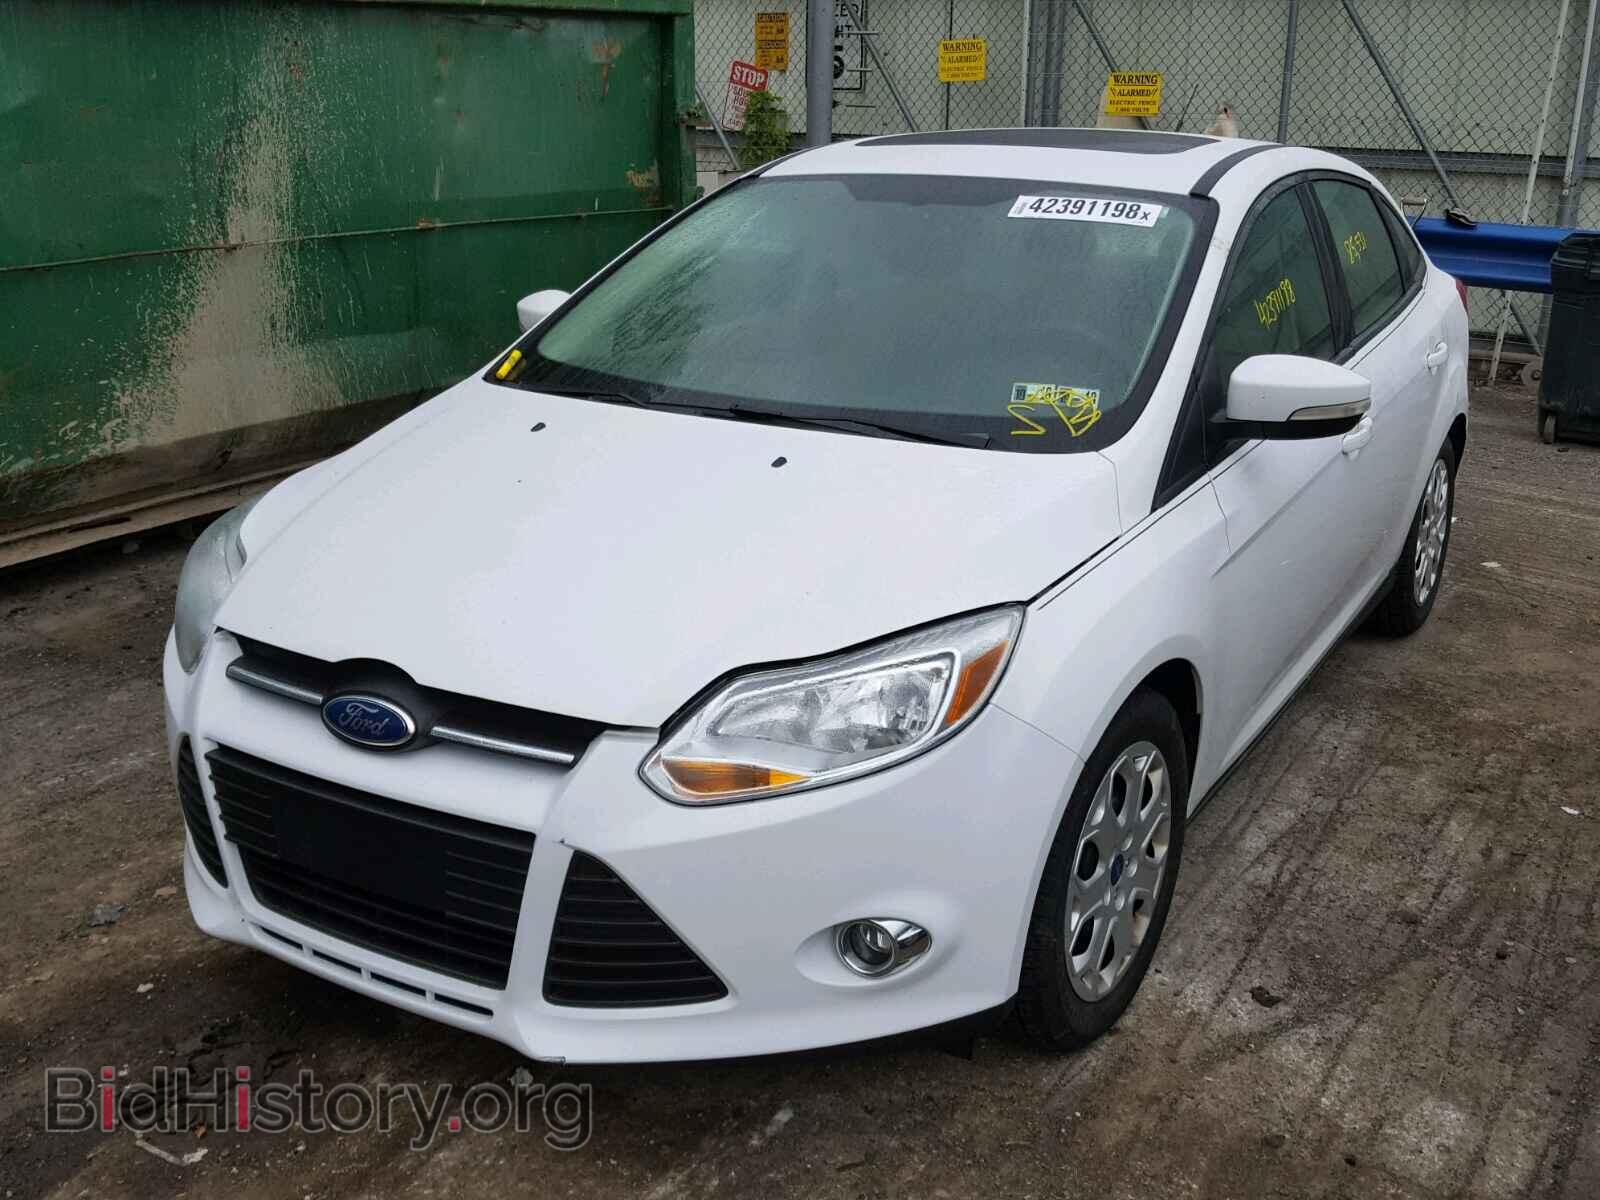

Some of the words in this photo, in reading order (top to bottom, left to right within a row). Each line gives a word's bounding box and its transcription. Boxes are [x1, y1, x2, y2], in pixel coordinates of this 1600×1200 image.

[943, 42, 982, 51] WARNING
[948, 55, 977, 63] ALARMED
[732, 65, 765, 87] STOP
[1114, 75, 1158, 84] WARNING
[1117, 88, 1151, 96] ALARMED
[339, 702, 390, 736] Ford
